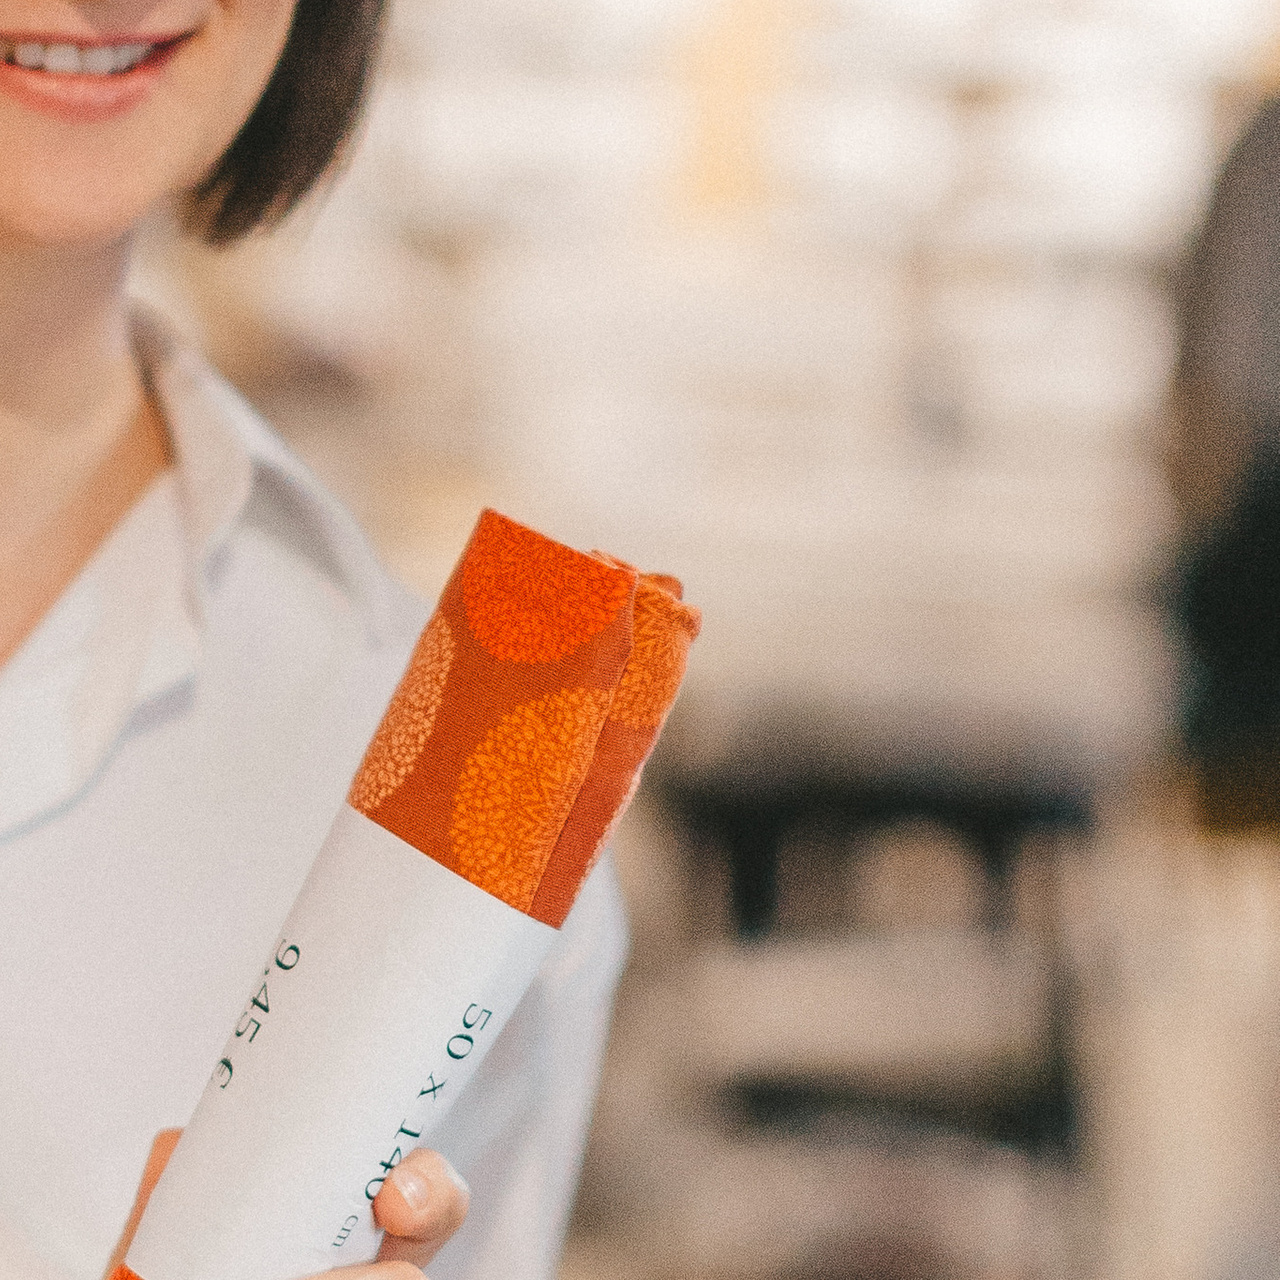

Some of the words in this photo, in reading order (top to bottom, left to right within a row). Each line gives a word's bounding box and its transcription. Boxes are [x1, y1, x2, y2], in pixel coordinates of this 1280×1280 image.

[446, 1003, 492, 1060] 50
[213, 1056, 233, 1089] €
[332, 1215, 359, 1247] cm
